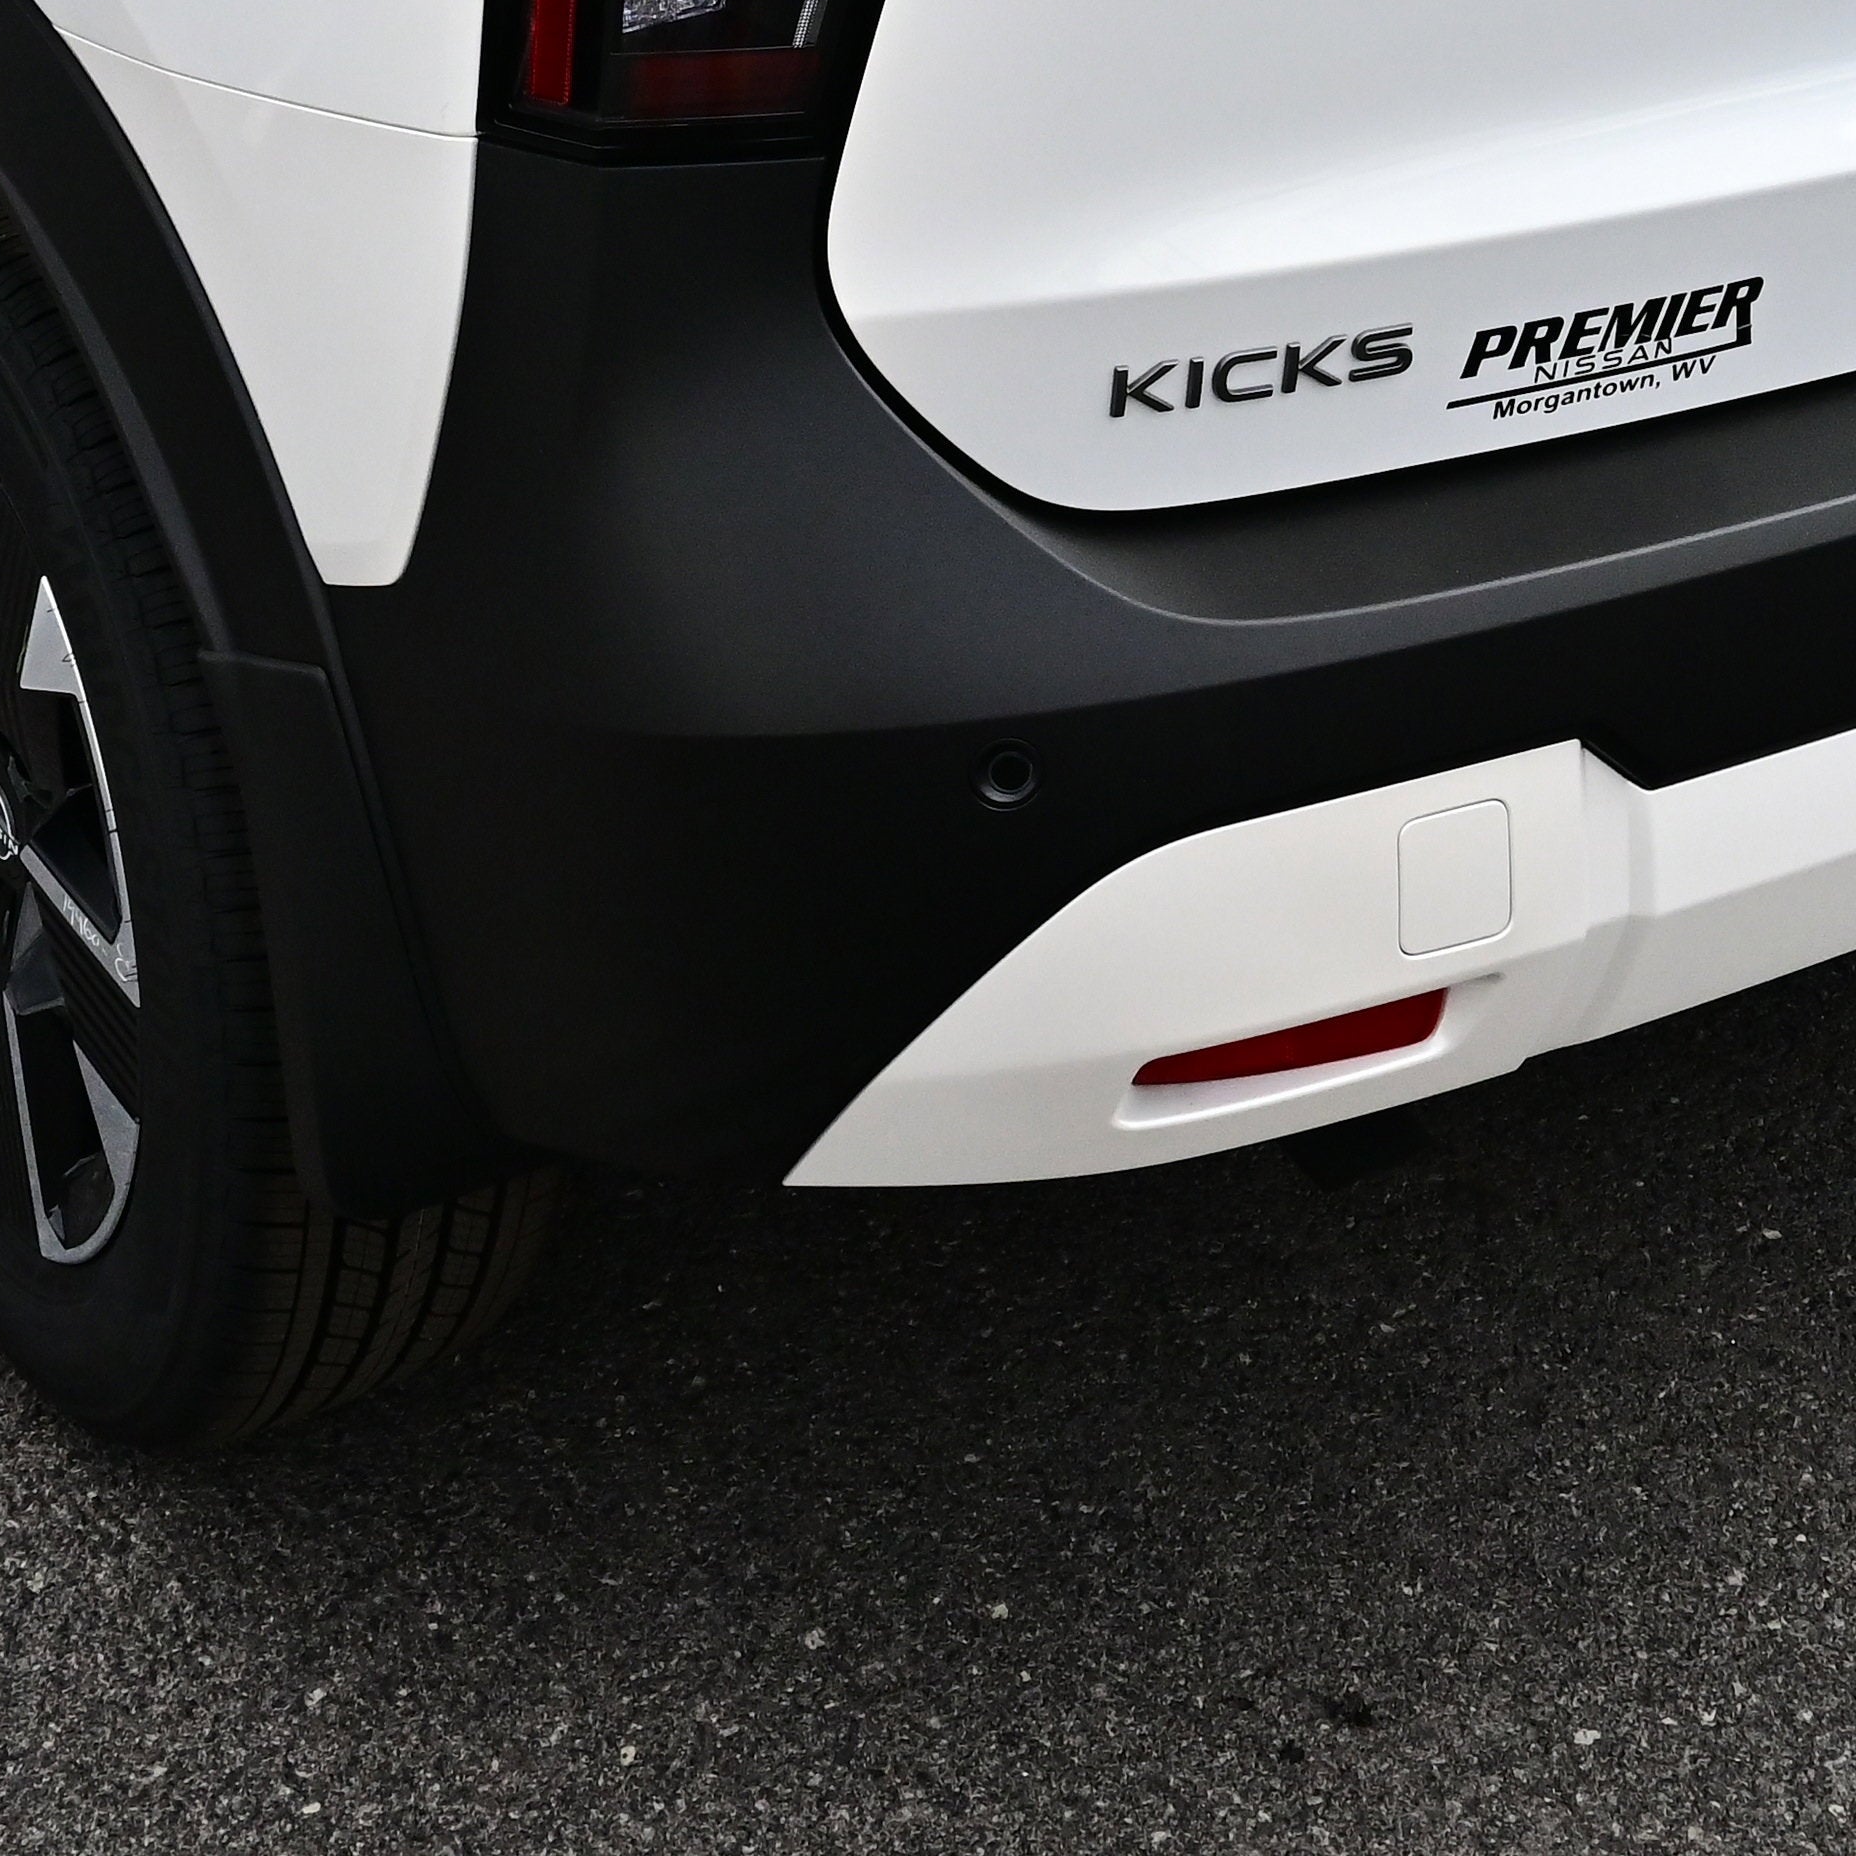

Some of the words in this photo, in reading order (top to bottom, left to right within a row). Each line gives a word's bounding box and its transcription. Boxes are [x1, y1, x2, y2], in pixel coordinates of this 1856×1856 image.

[1459, 276, 1764, 380] PREMIER
[1534, 337, 1673, 384] NISSAN
[1109, 322, 1414, 418] KICKS
[1493, 373, 1661, 420] Morgantown,
[1670, 355, 1717, 382] WV
